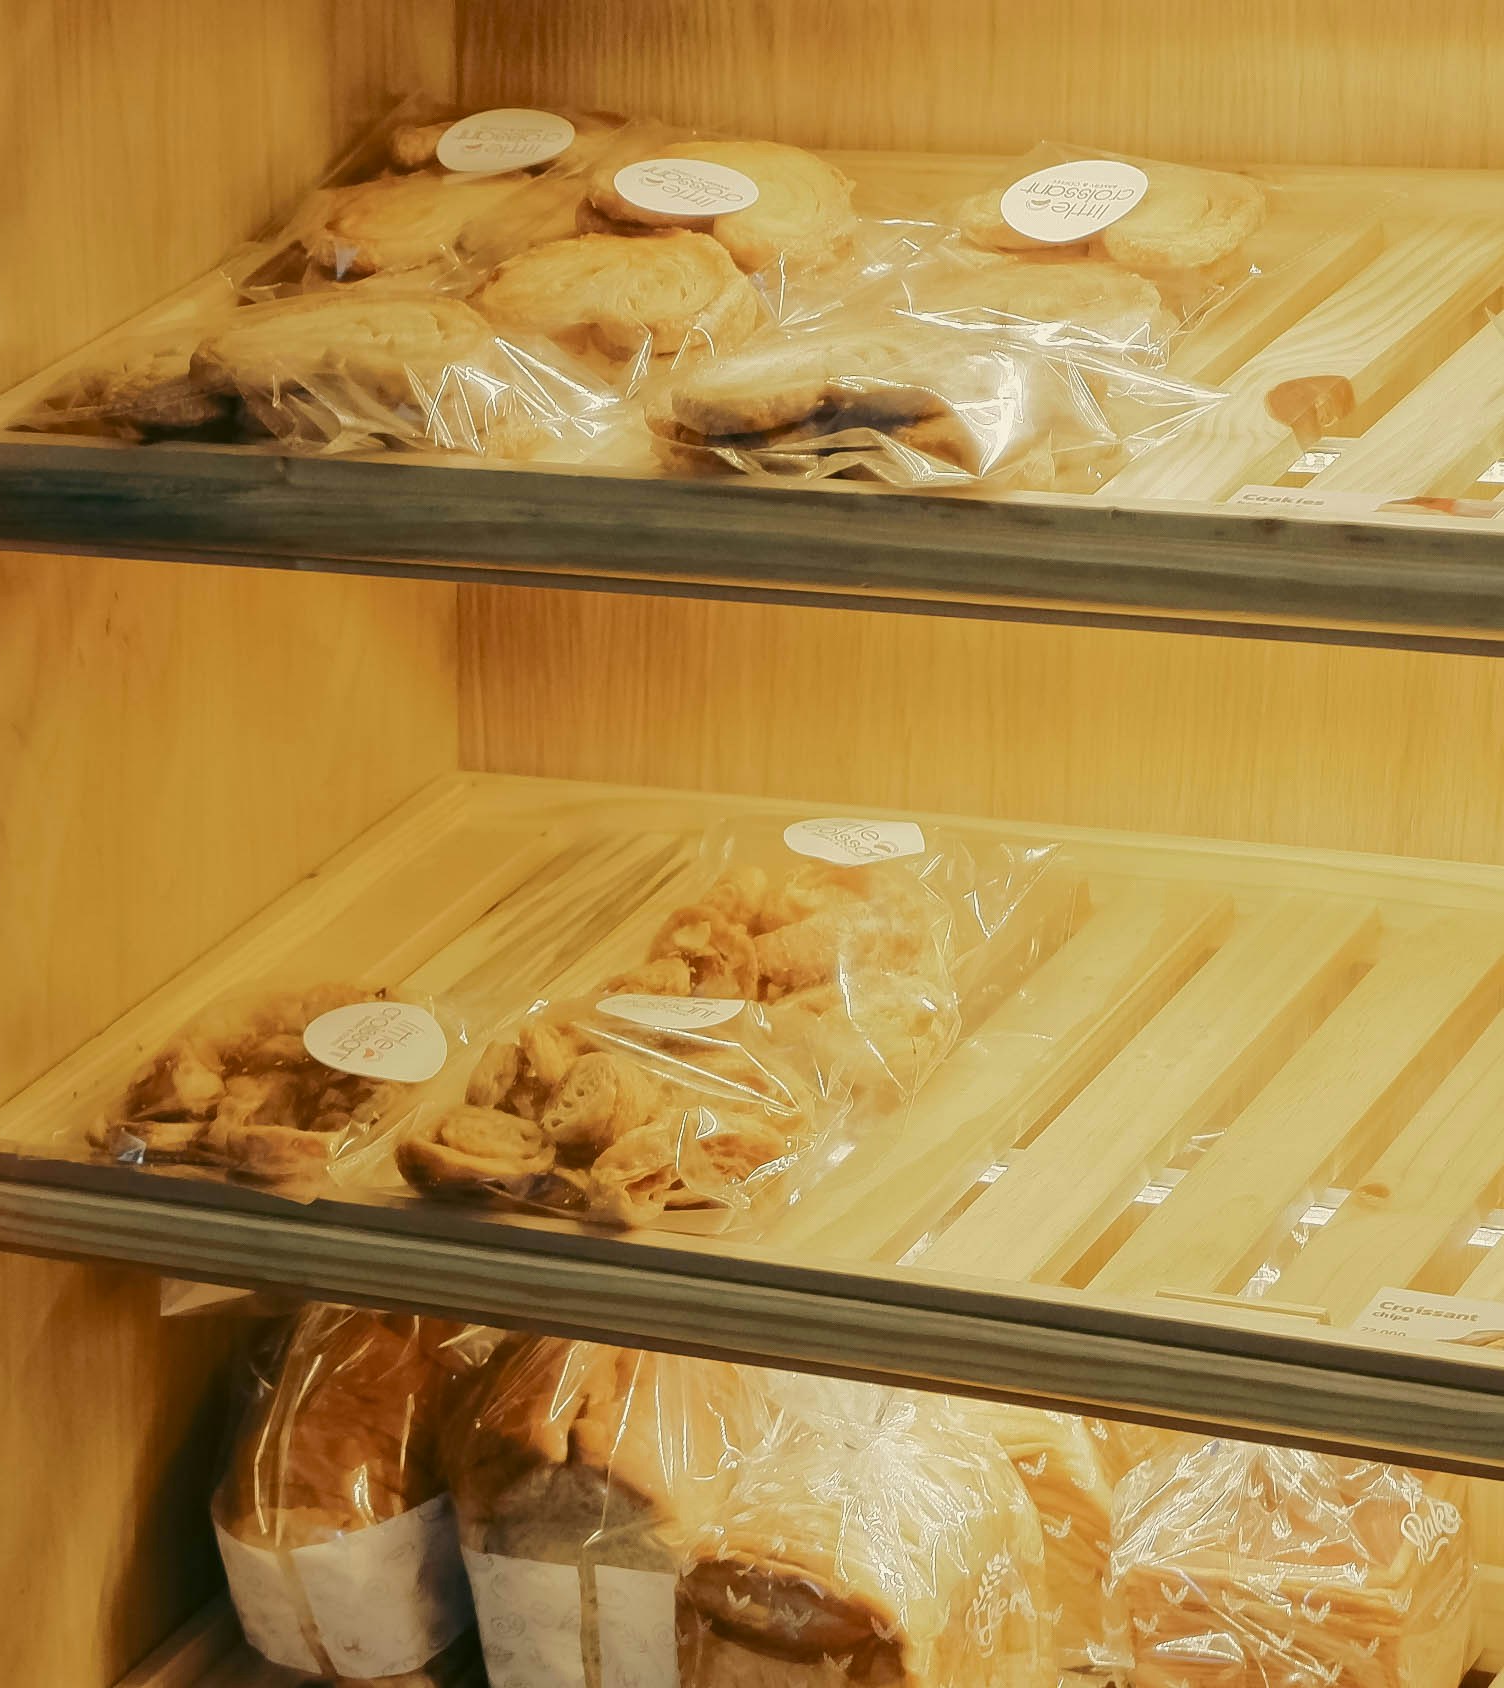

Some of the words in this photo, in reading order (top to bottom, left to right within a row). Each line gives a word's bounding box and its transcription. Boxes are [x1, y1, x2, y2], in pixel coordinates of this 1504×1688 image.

[1019, 181, 1135, 203] croissant
[1050, 200, 1111, 220] little
[1242, 494, 1325, 506] Cookies
[1371, 1310, 1410, 1322] chips
[1379, 1301, 1480, 1322] Croissant
